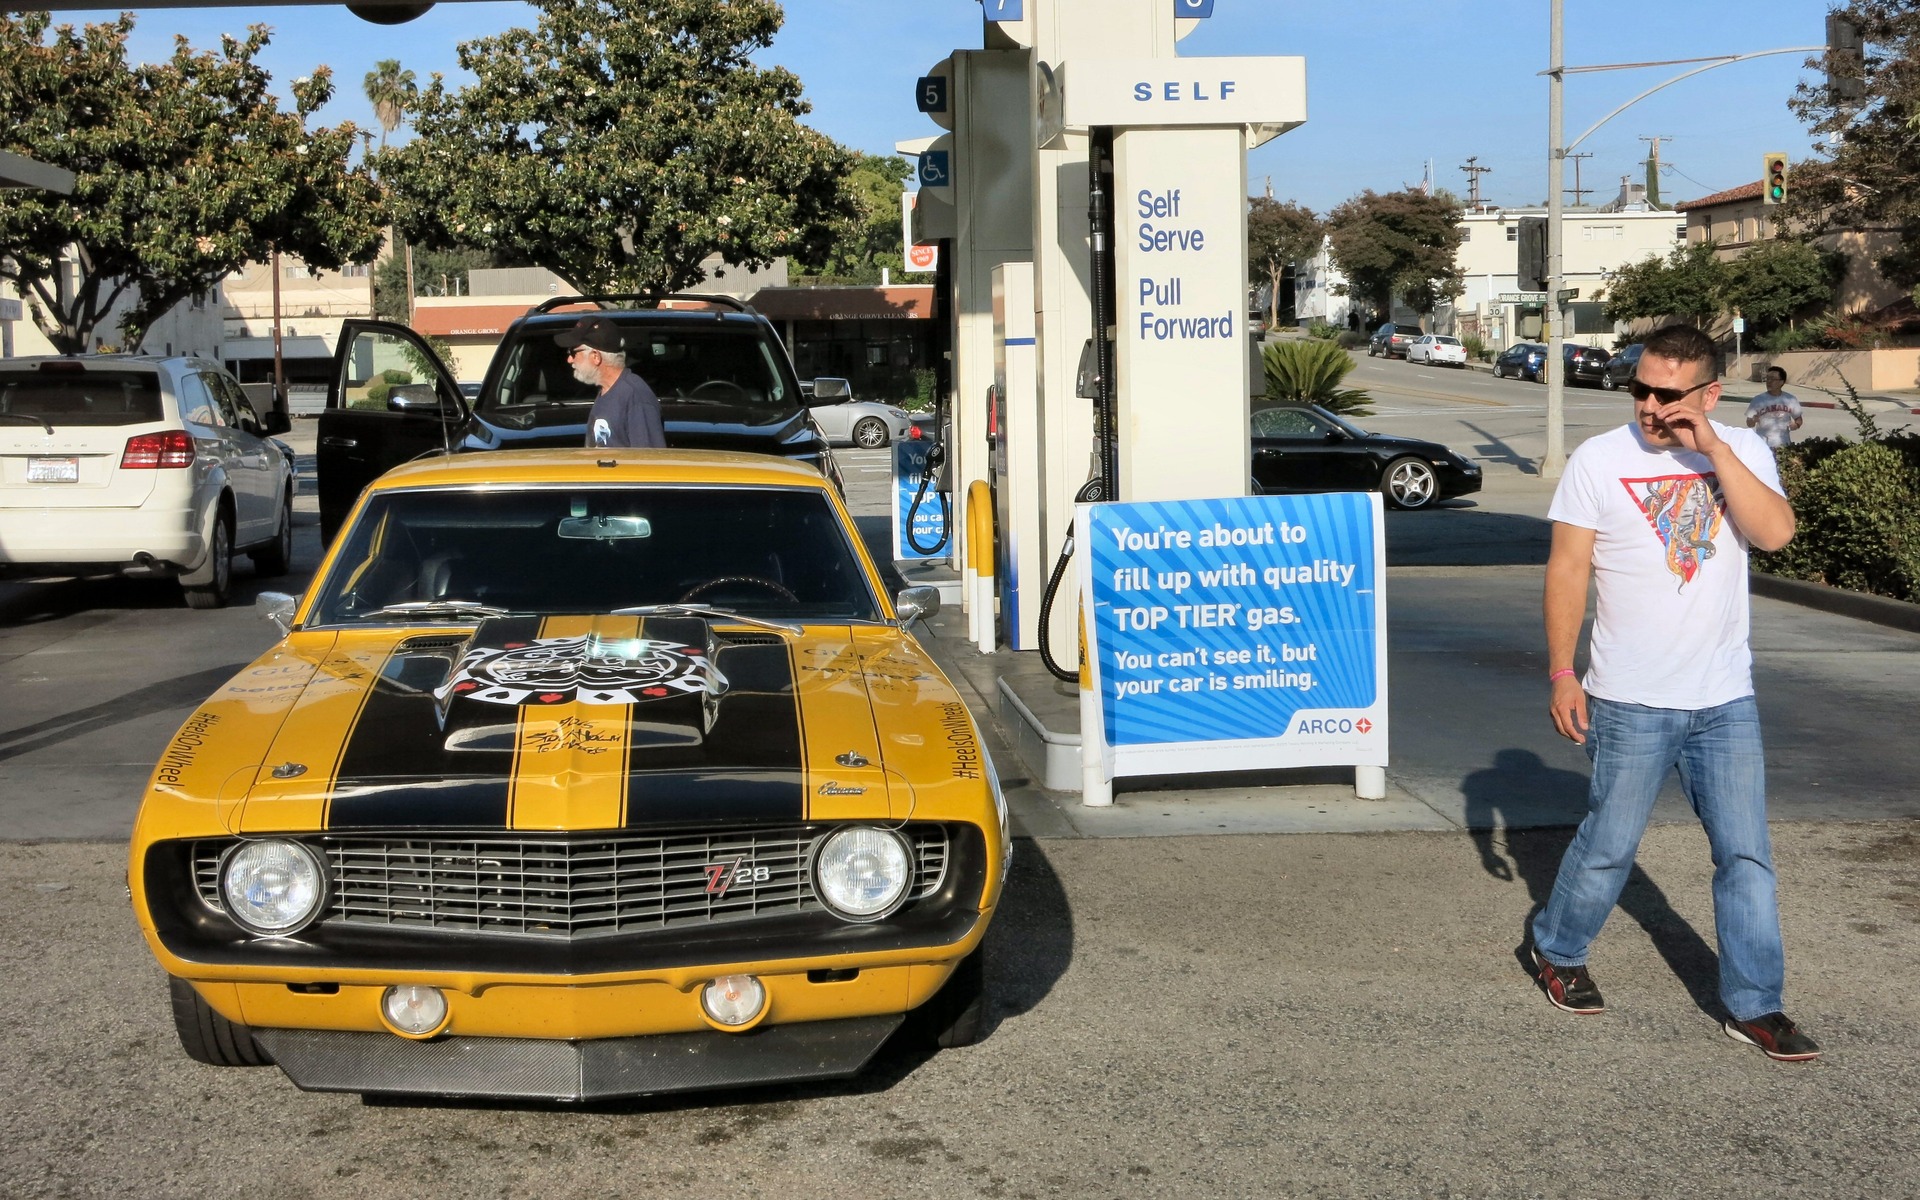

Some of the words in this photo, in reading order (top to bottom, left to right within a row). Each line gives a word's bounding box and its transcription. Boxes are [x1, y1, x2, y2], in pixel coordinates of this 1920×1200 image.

[925, 84, 939, 105] 5
[1133, 81, 1236, 102] SELF
[1137, 189, 1181, 219] Self
[1138, 222, 1205, 252] Serve
[911, 248, 932, 257] SINCE
[1139, 277, 1181, 306] Pull
[828, 312, 859, 320] ORANGE
[1140, 310, 1234, 340] Forward
[1489, 308, 1500, 316] 30
[1759, 404, 1792, 416] CANADA
[1112, 525, 1192, 551] You're
[1199, 523, 1274, 547] about
[1281, 521, 1307, 544] to
[1113, 567, 1151, 592] fill
[1158, 570, 1192, 595] up
[1198, 563, 1256, 588] with
[1264, 559, 1356, 590] quality
[1113, 607, 1169, 632] TOP
[1247, 606, 1301, 631] gas.
[1115, 651, 1152, 670] You
[1158, 647, 1209, 667] can't
[1213, 648, 1251, 665] see
[1257, 644, 1277, 665] it,
[1282, 643, 1317, 662] but
[1115, 679, 1164, 700] your
[1168, 676, 1204, 693] car
[1209, 672, 1228, 690] is
[1233, 669, 1318, 691] smiling.
[936, 701, 979, 779] #HeelsOnWheels
[1297, 718, 1353, 735] ARCO
